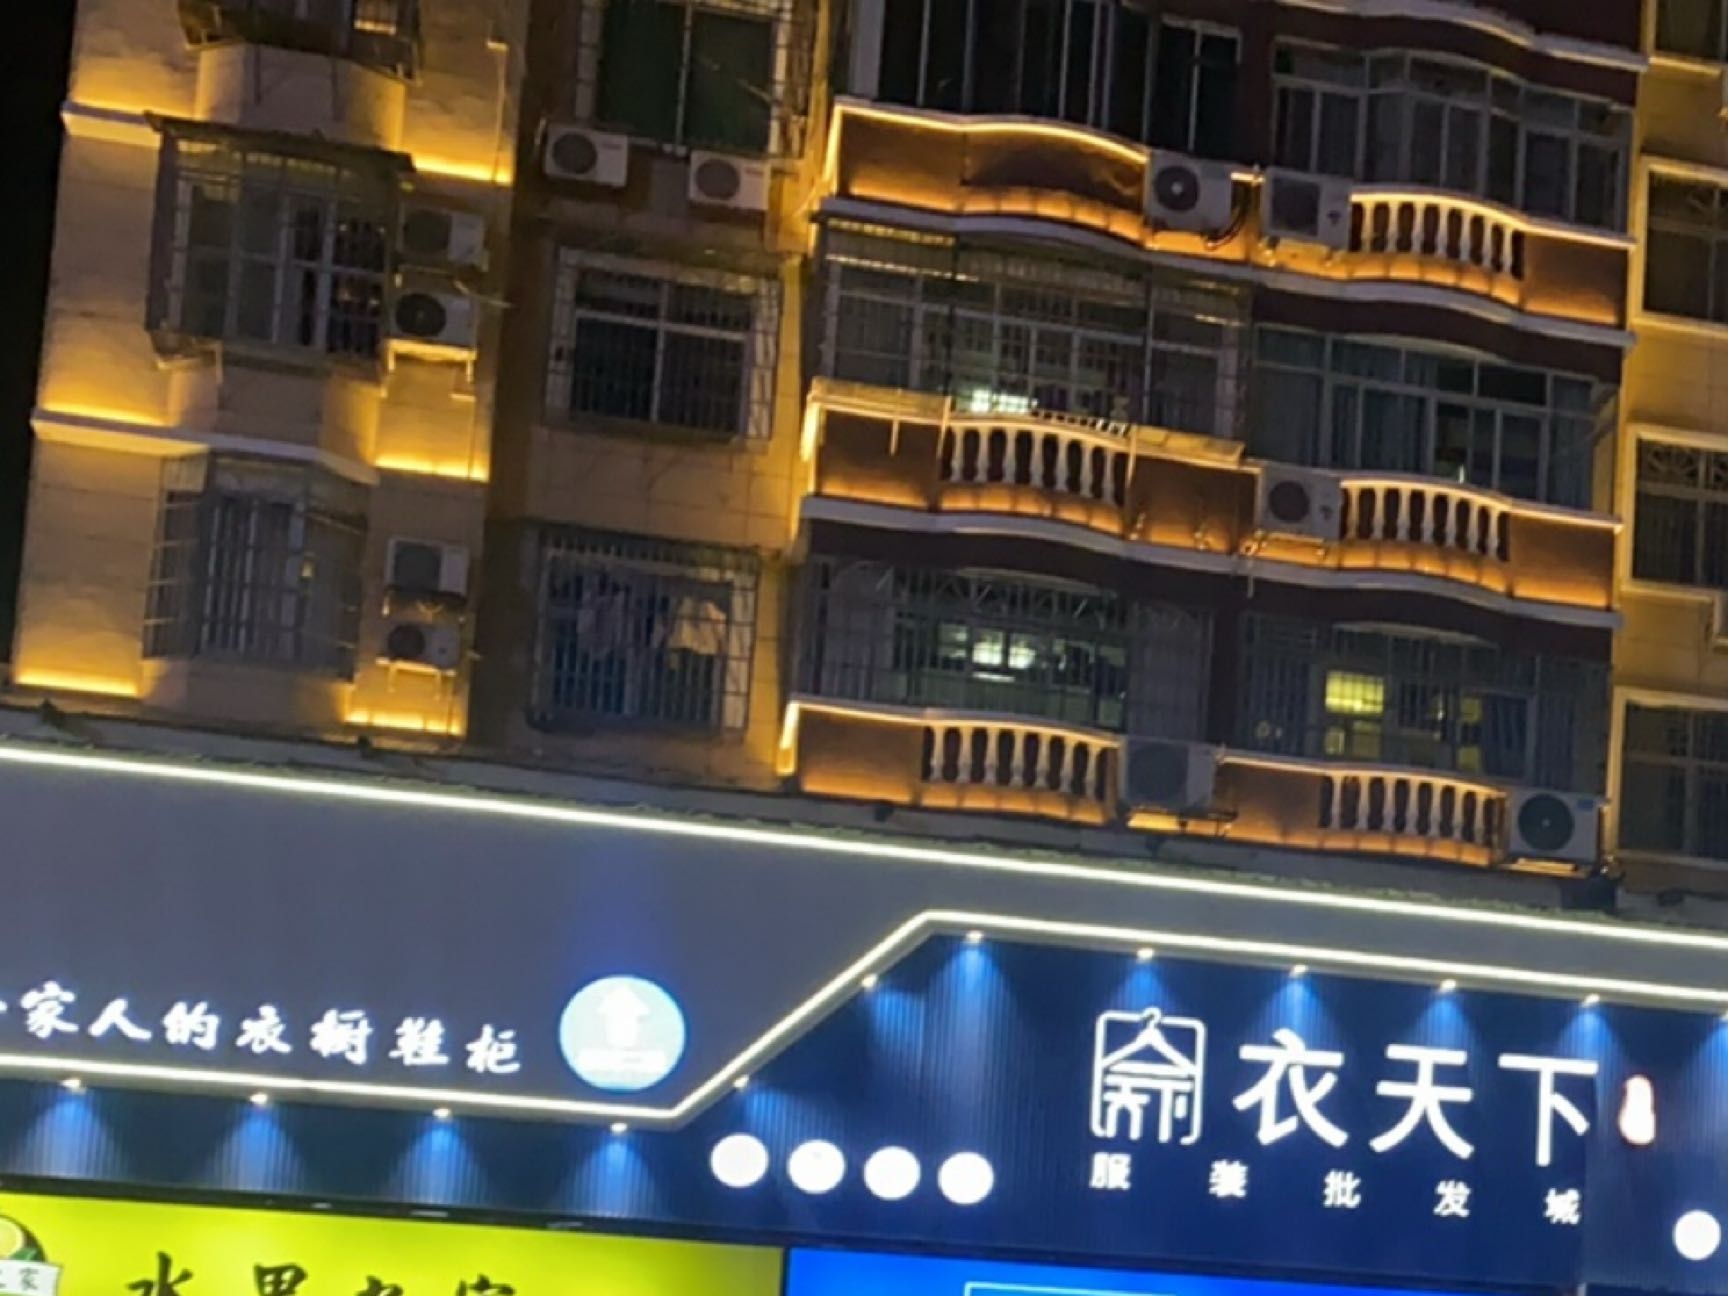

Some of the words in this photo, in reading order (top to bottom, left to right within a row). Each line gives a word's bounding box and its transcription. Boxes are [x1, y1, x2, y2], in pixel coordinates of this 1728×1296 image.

[0, 981, 521, 1074] 家人的衣橱鞋柜
[1233, 1028, 1598, 1167] 衣天下
[1090, 1153, 1581, 1225] 服装批发城
